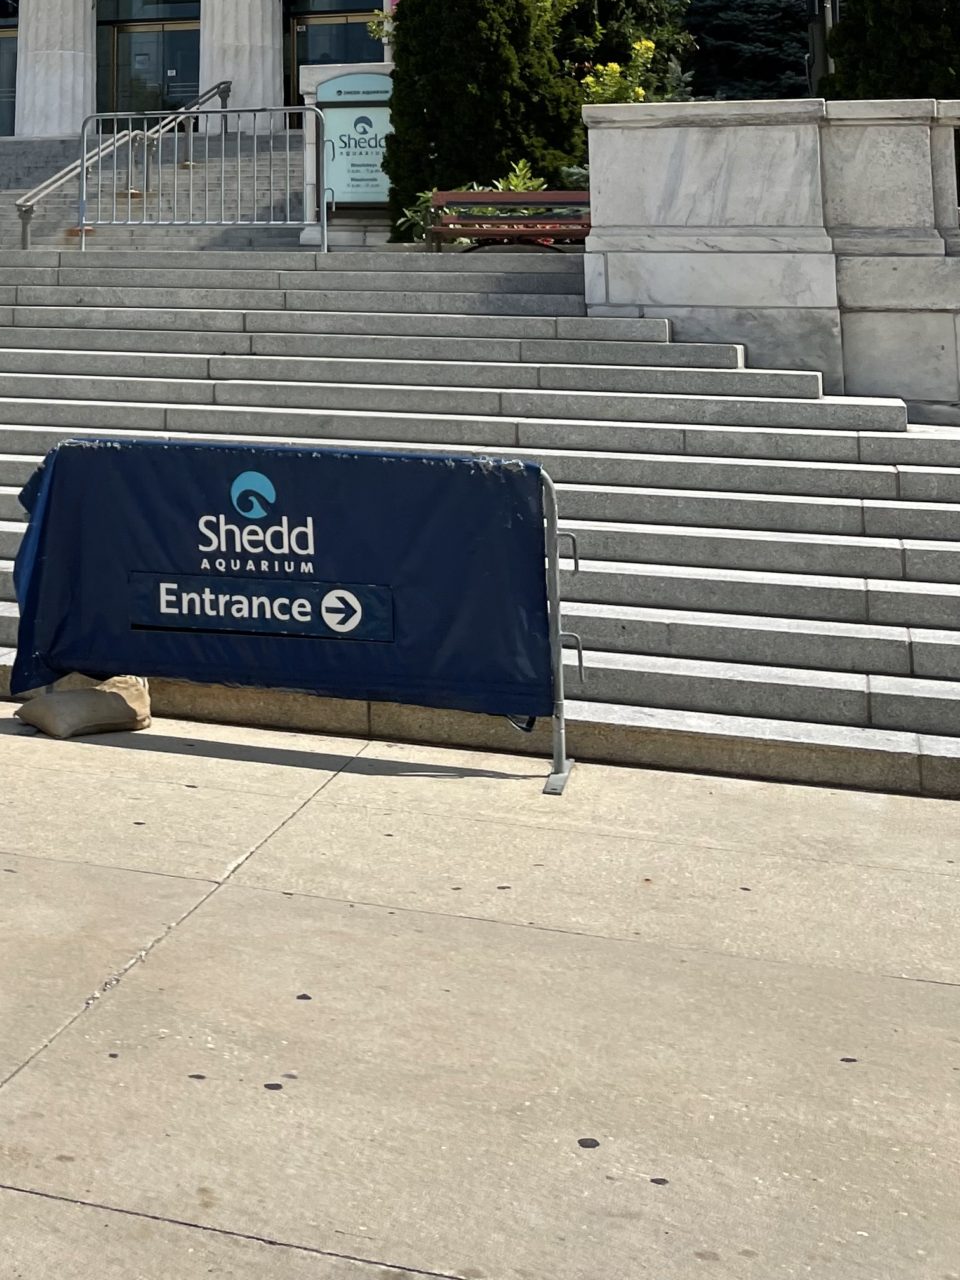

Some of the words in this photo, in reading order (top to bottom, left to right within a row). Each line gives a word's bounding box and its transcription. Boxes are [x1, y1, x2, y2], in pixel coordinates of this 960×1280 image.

[198, 514, 315, 556] Shedd
[200, 557, 314, 574] AQUARIUM
[158, 581, 312, 622] Entrance
